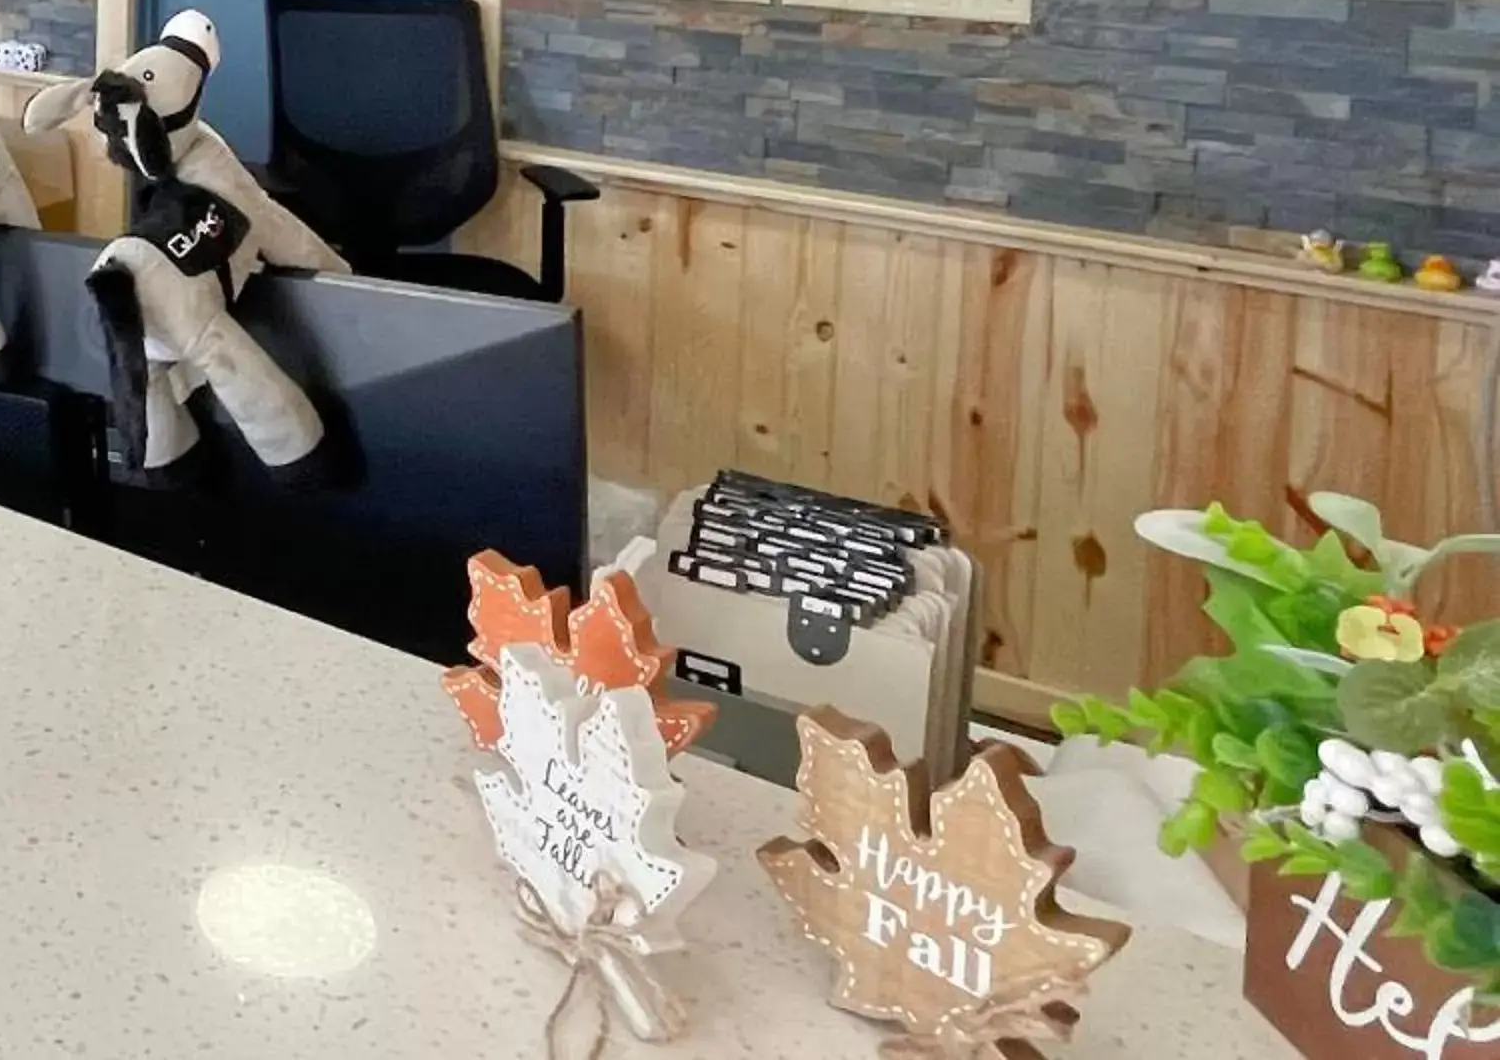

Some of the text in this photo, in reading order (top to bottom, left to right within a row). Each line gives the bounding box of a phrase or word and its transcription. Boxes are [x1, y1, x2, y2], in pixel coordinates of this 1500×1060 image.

[542, 758, 619, 842] Leaves
[556, 809, 595, 849] are
[855, 824, 1020, 946] Happy
[861, 891, 992, 1000] Fall
